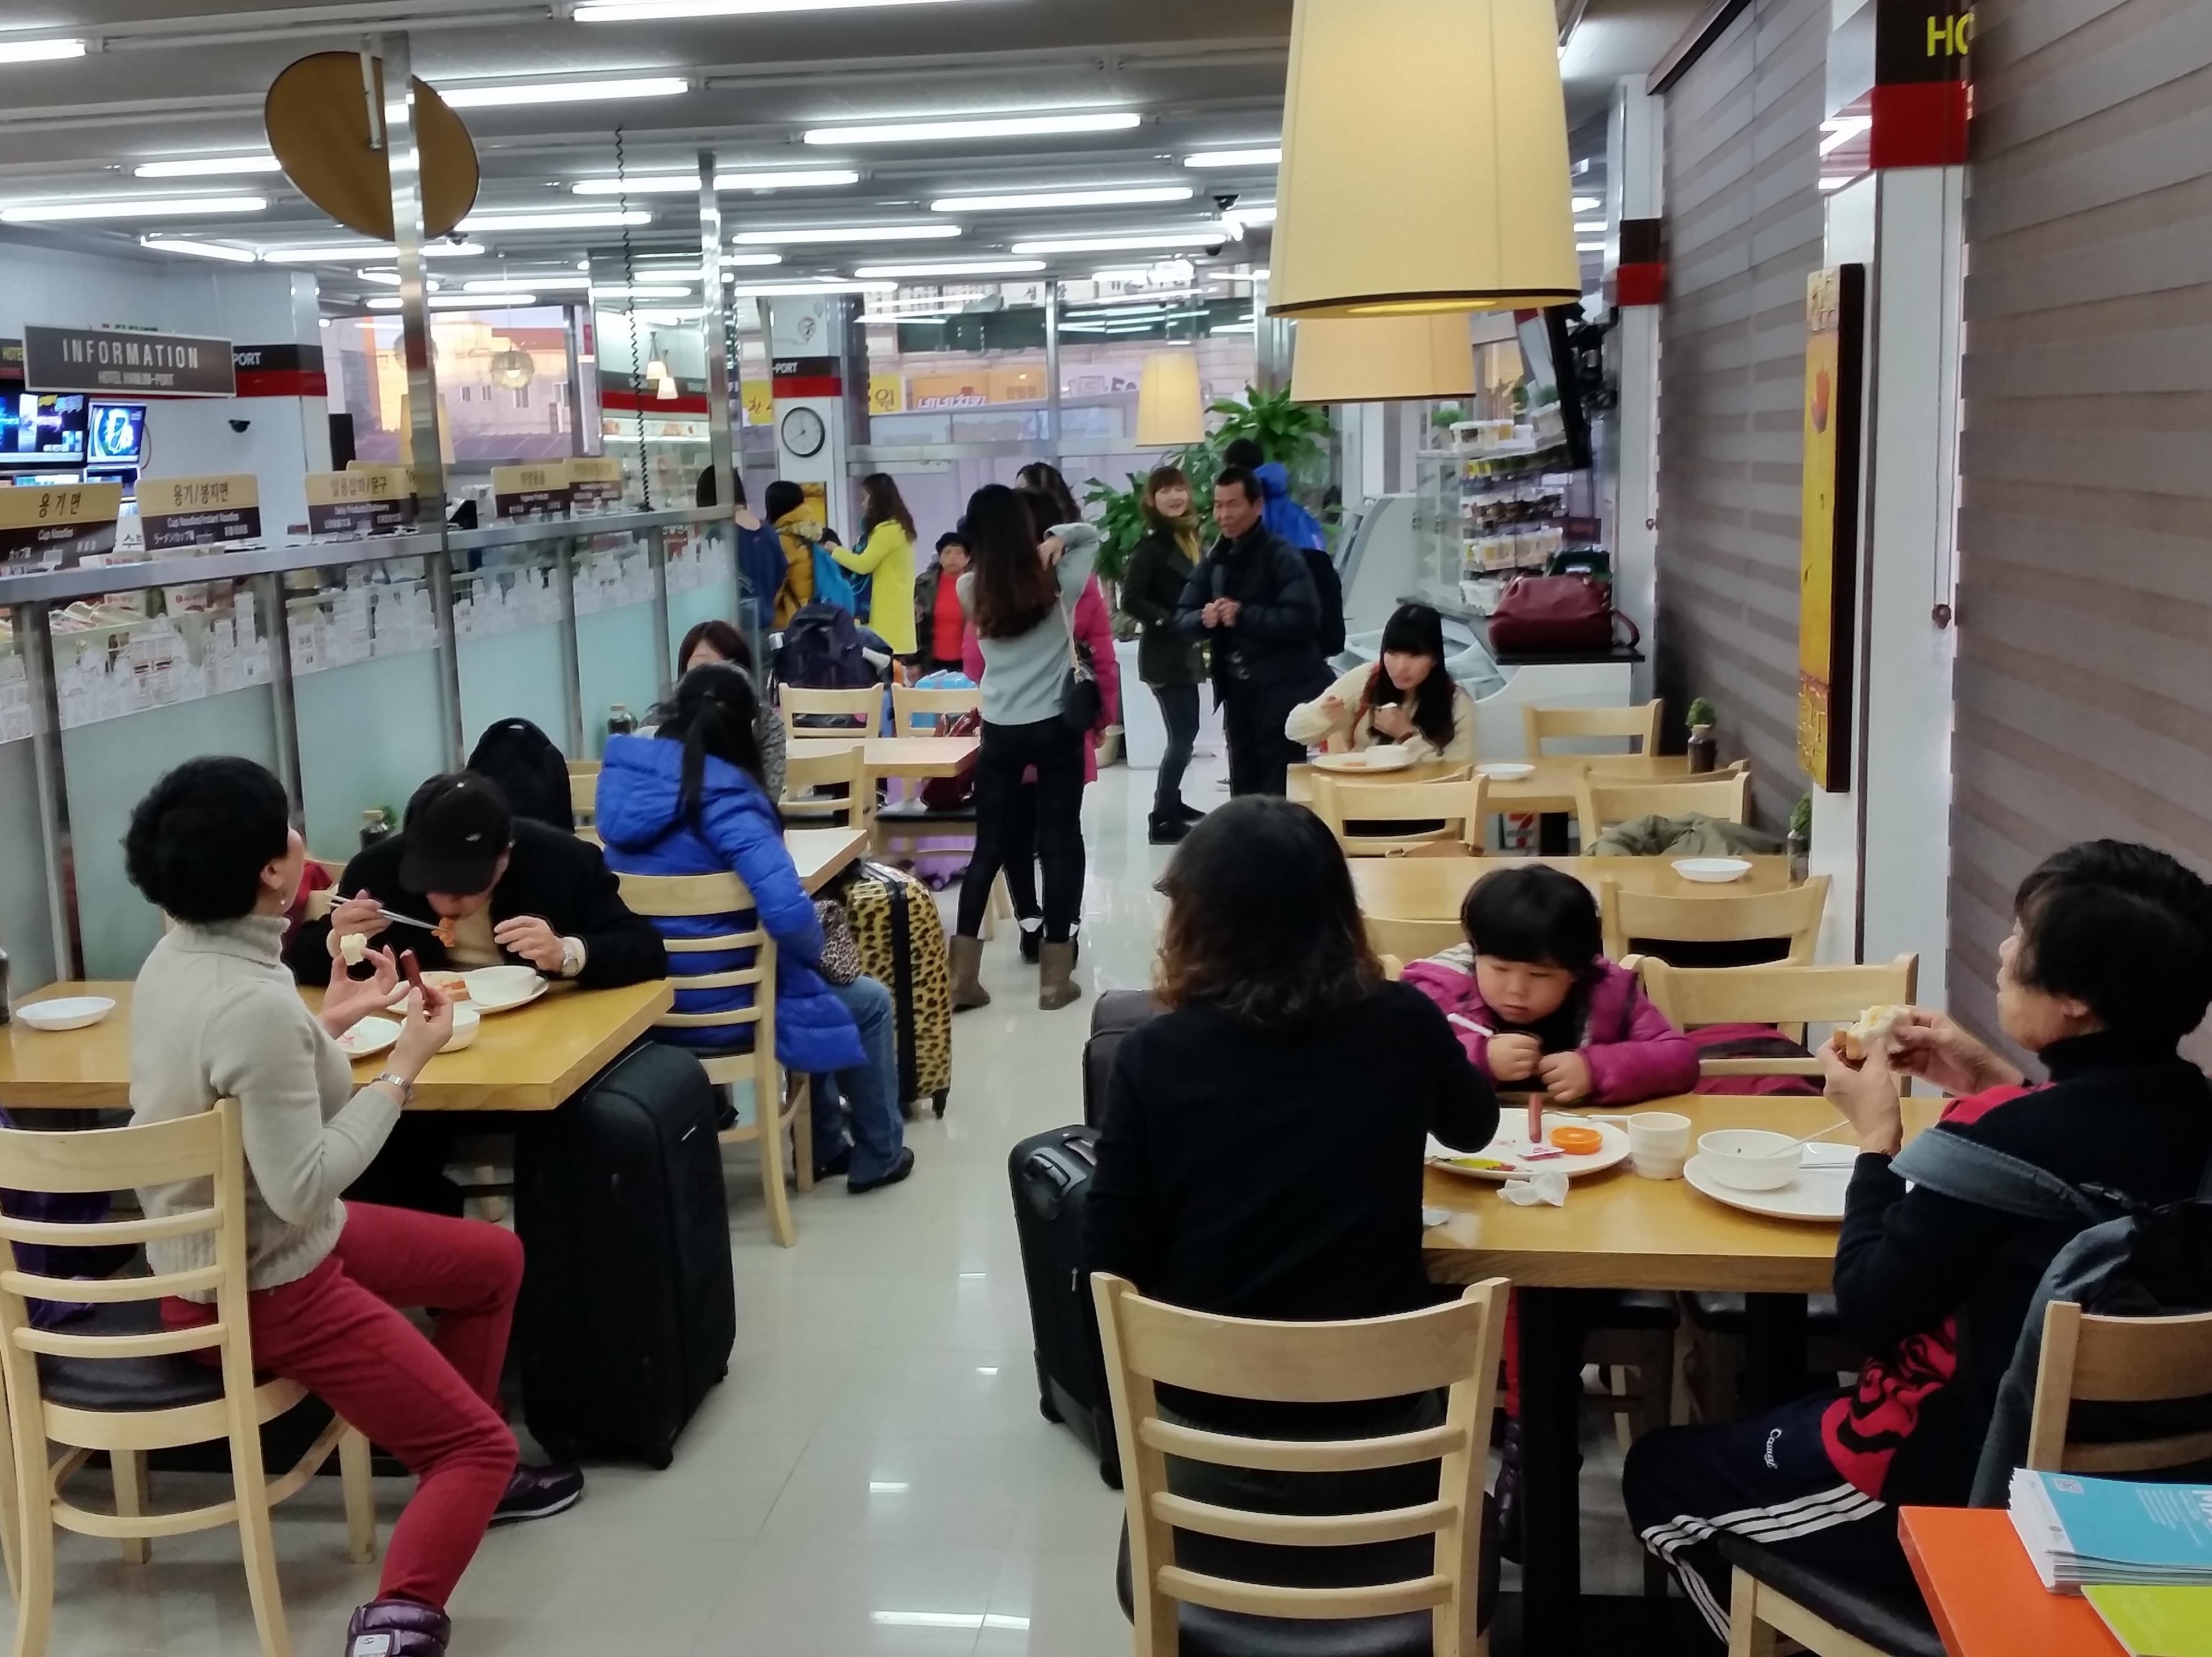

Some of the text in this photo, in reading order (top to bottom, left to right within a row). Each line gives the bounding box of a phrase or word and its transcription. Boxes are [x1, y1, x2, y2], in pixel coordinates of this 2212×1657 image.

[2, 347, 23, 361] HOTE
[62, 339, 198, 369] INFORMATION
[174, 482, 228, 507] 용기/봉지면
